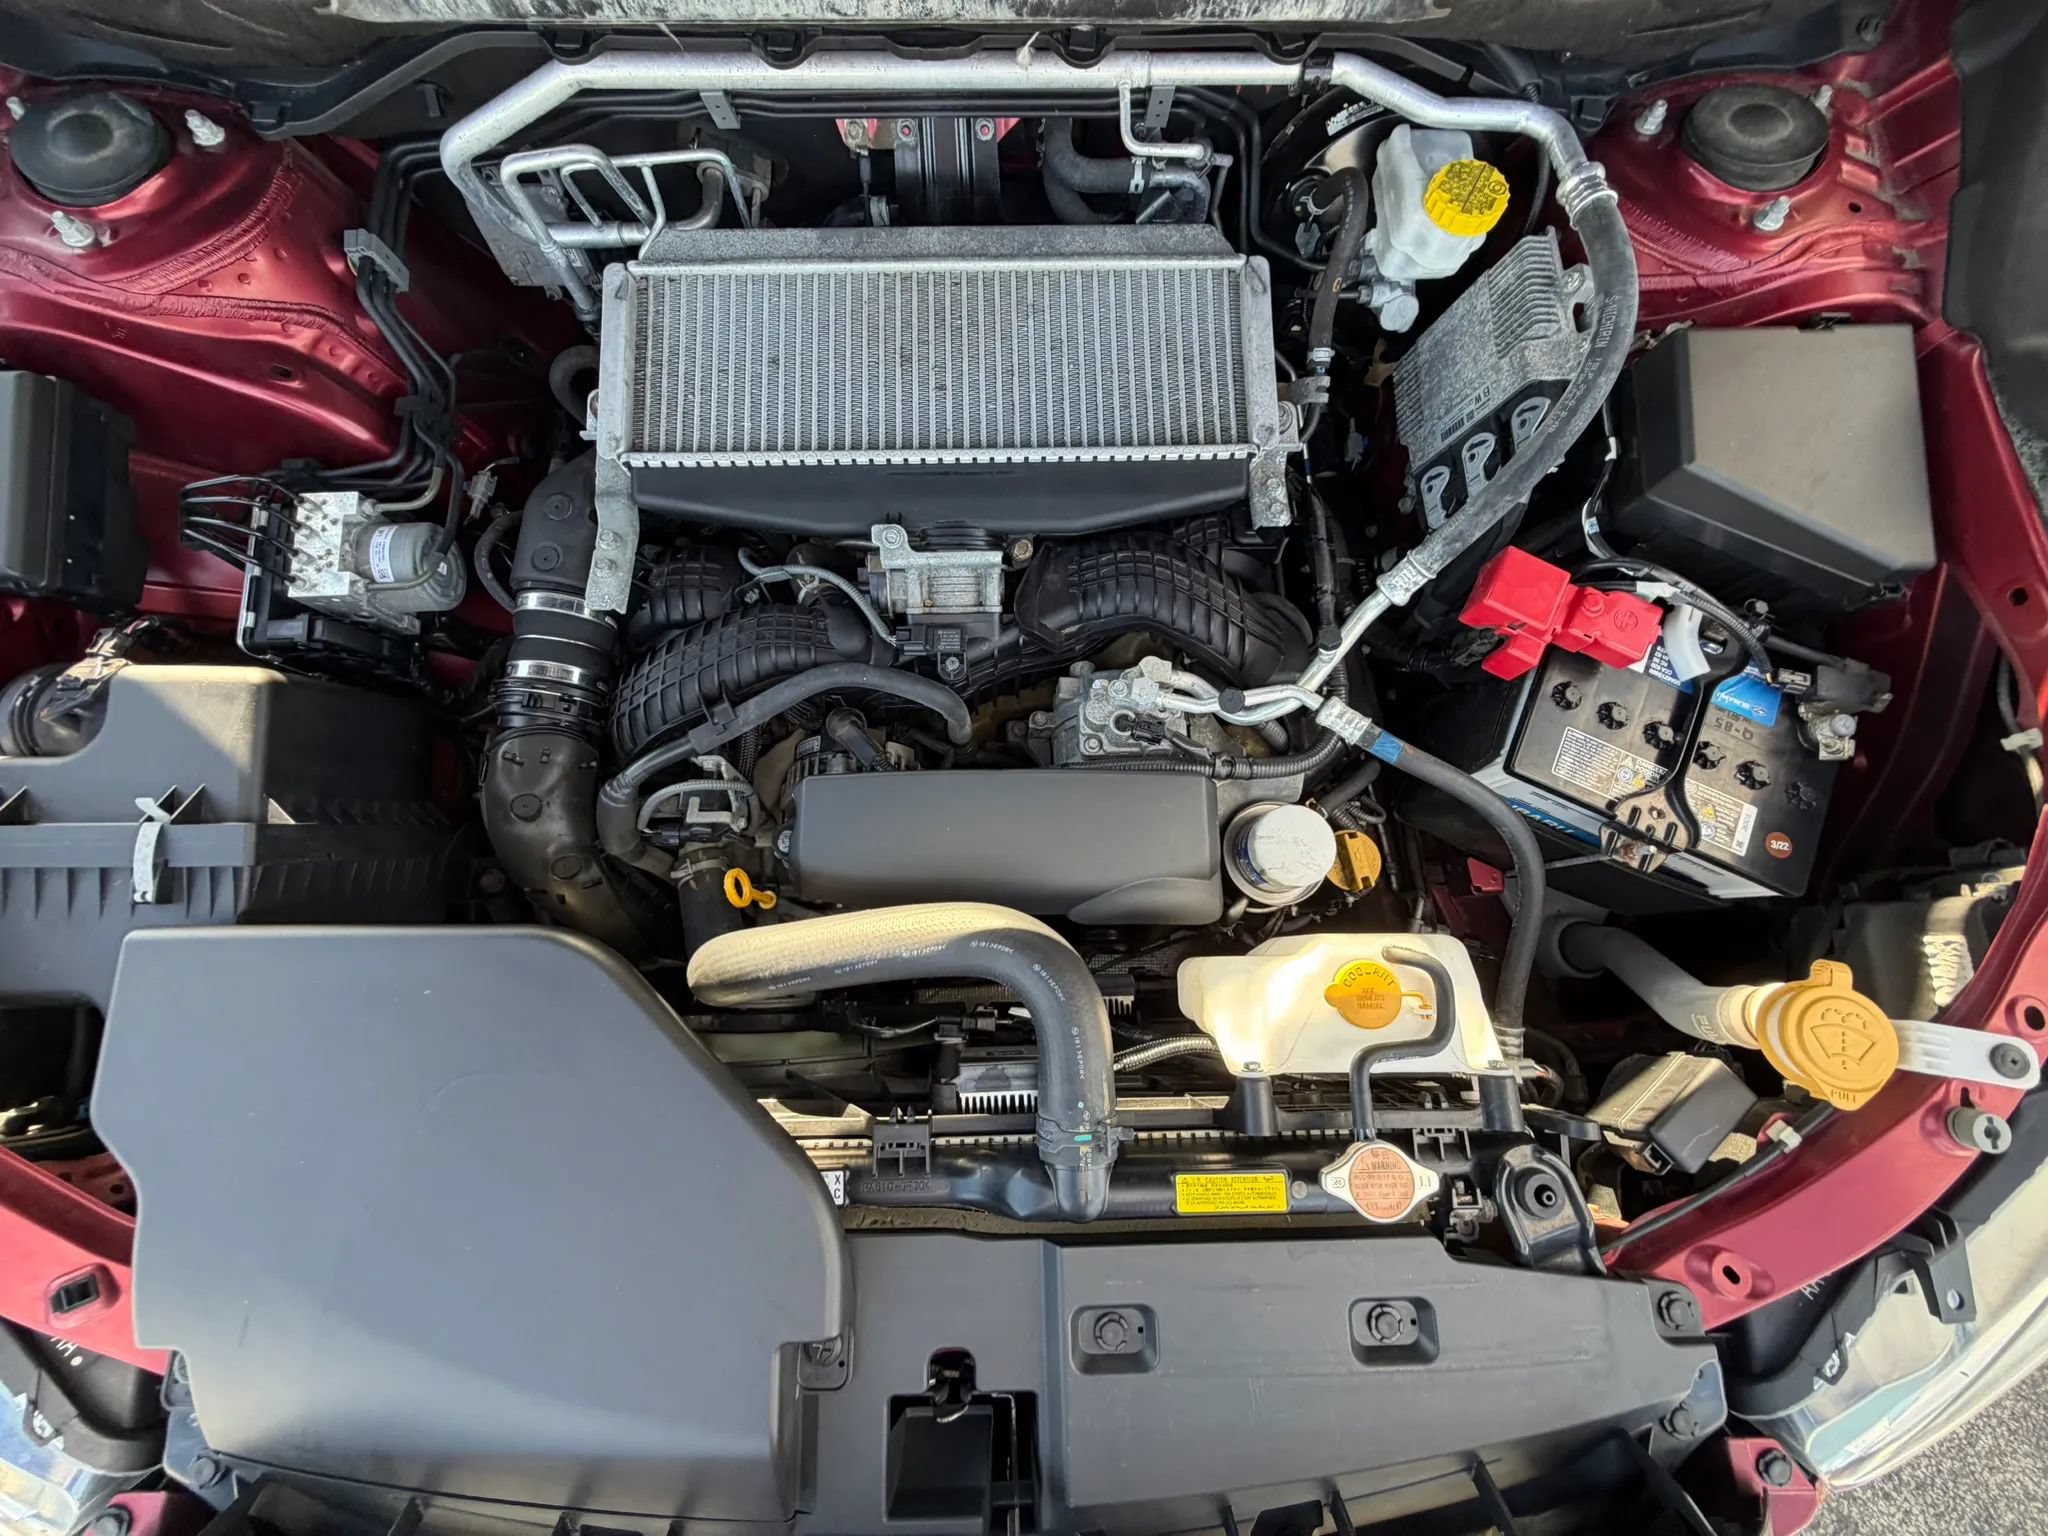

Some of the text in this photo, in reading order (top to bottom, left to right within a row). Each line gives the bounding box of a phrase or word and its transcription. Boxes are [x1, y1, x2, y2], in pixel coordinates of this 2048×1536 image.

[1714, 717, 1754, 740] Q-85
[1770, 839, 1790, 851] 3/22
[1343, 966, 1396, 988] COOLANT
[1830, 1089, 1857, 1103] PULL
